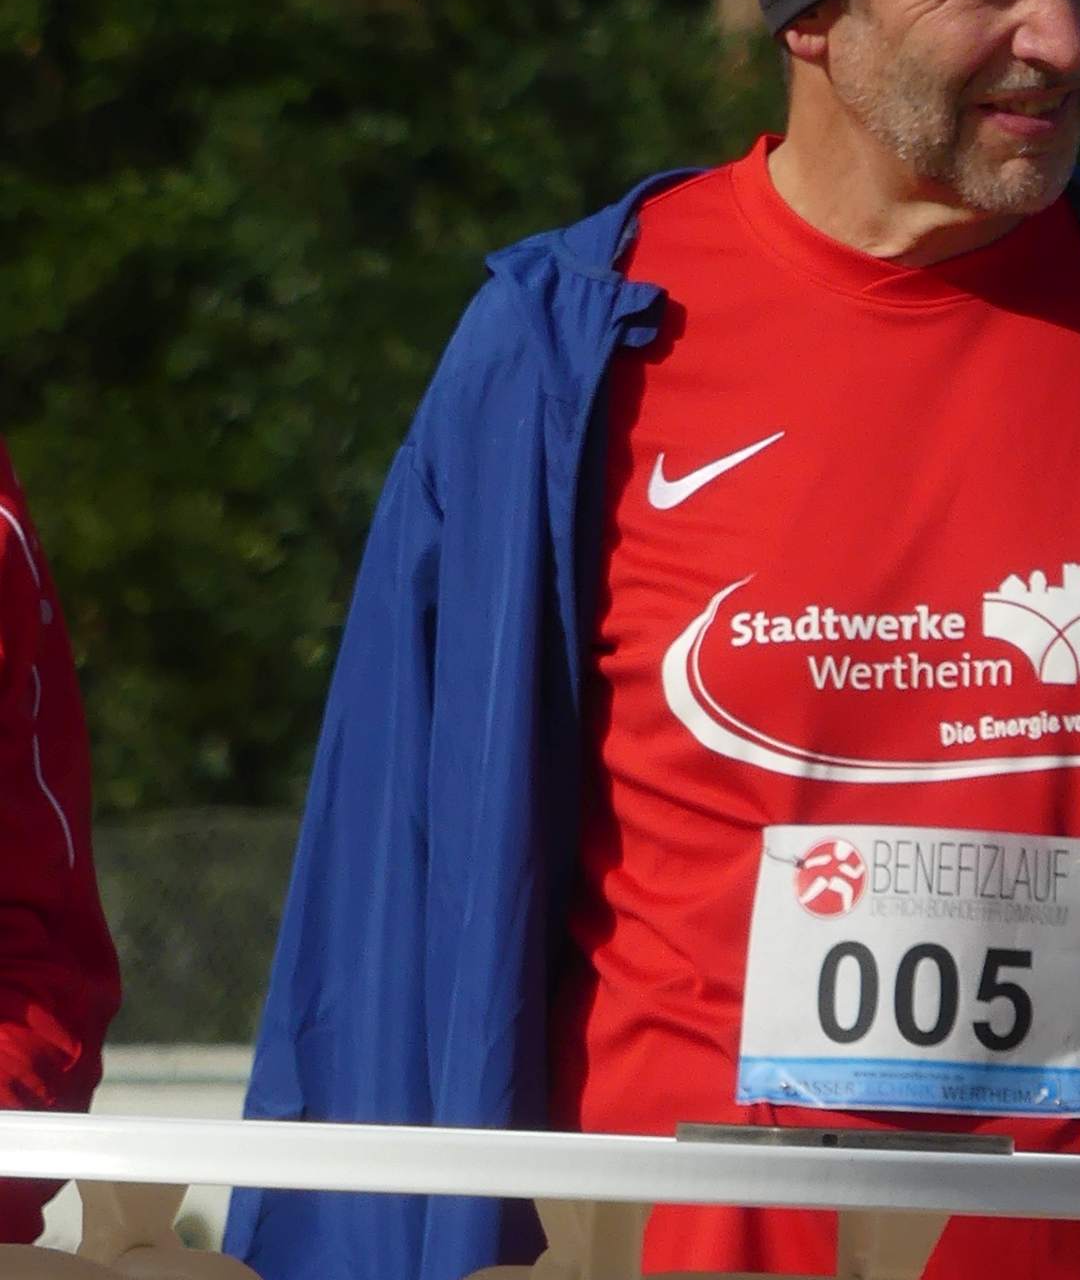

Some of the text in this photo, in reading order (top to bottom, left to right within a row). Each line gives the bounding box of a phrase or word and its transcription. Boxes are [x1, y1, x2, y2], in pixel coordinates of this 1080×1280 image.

[730, 604, 966, 647] Stadtwerke
[807, 651, 1013, 690] Wertheim
[939, 721, 976, 747] Die
[979, 710, 1061, 741] Energie
[871, 839, 1069, 903] BENEFIZLAUF
[816, 940, 1034, 1053] 005
